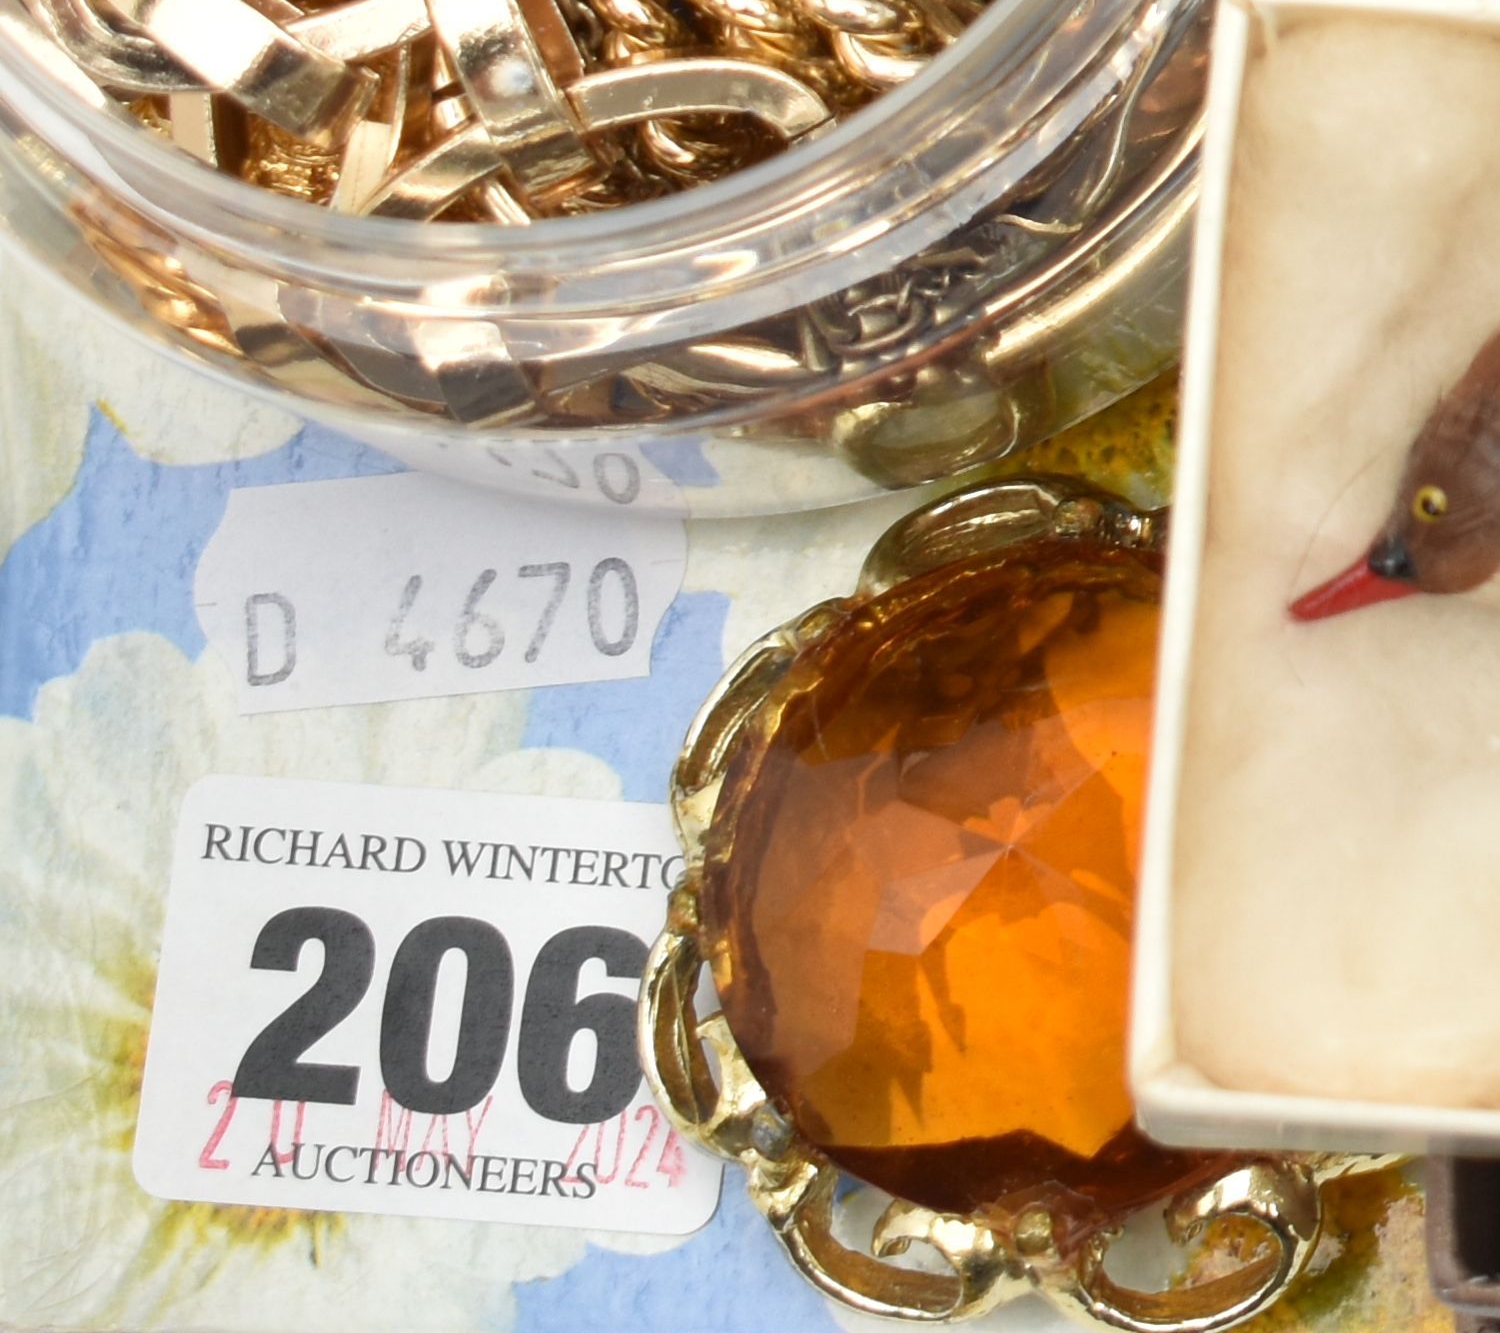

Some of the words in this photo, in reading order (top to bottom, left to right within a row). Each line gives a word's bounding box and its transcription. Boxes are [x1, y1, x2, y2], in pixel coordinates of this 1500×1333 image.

[245, 591, 299, 688] D
[383, 555, 641, 675] 4670
[200, 822, 427, 874] RICHARD
[442, 839, 686, 891] WINTERTO
[231, 905, 652, 1125] 206
[251, 1141, 599, 1200] AUCTIONEERS
[374, 1089, 494, 1175] MAY
